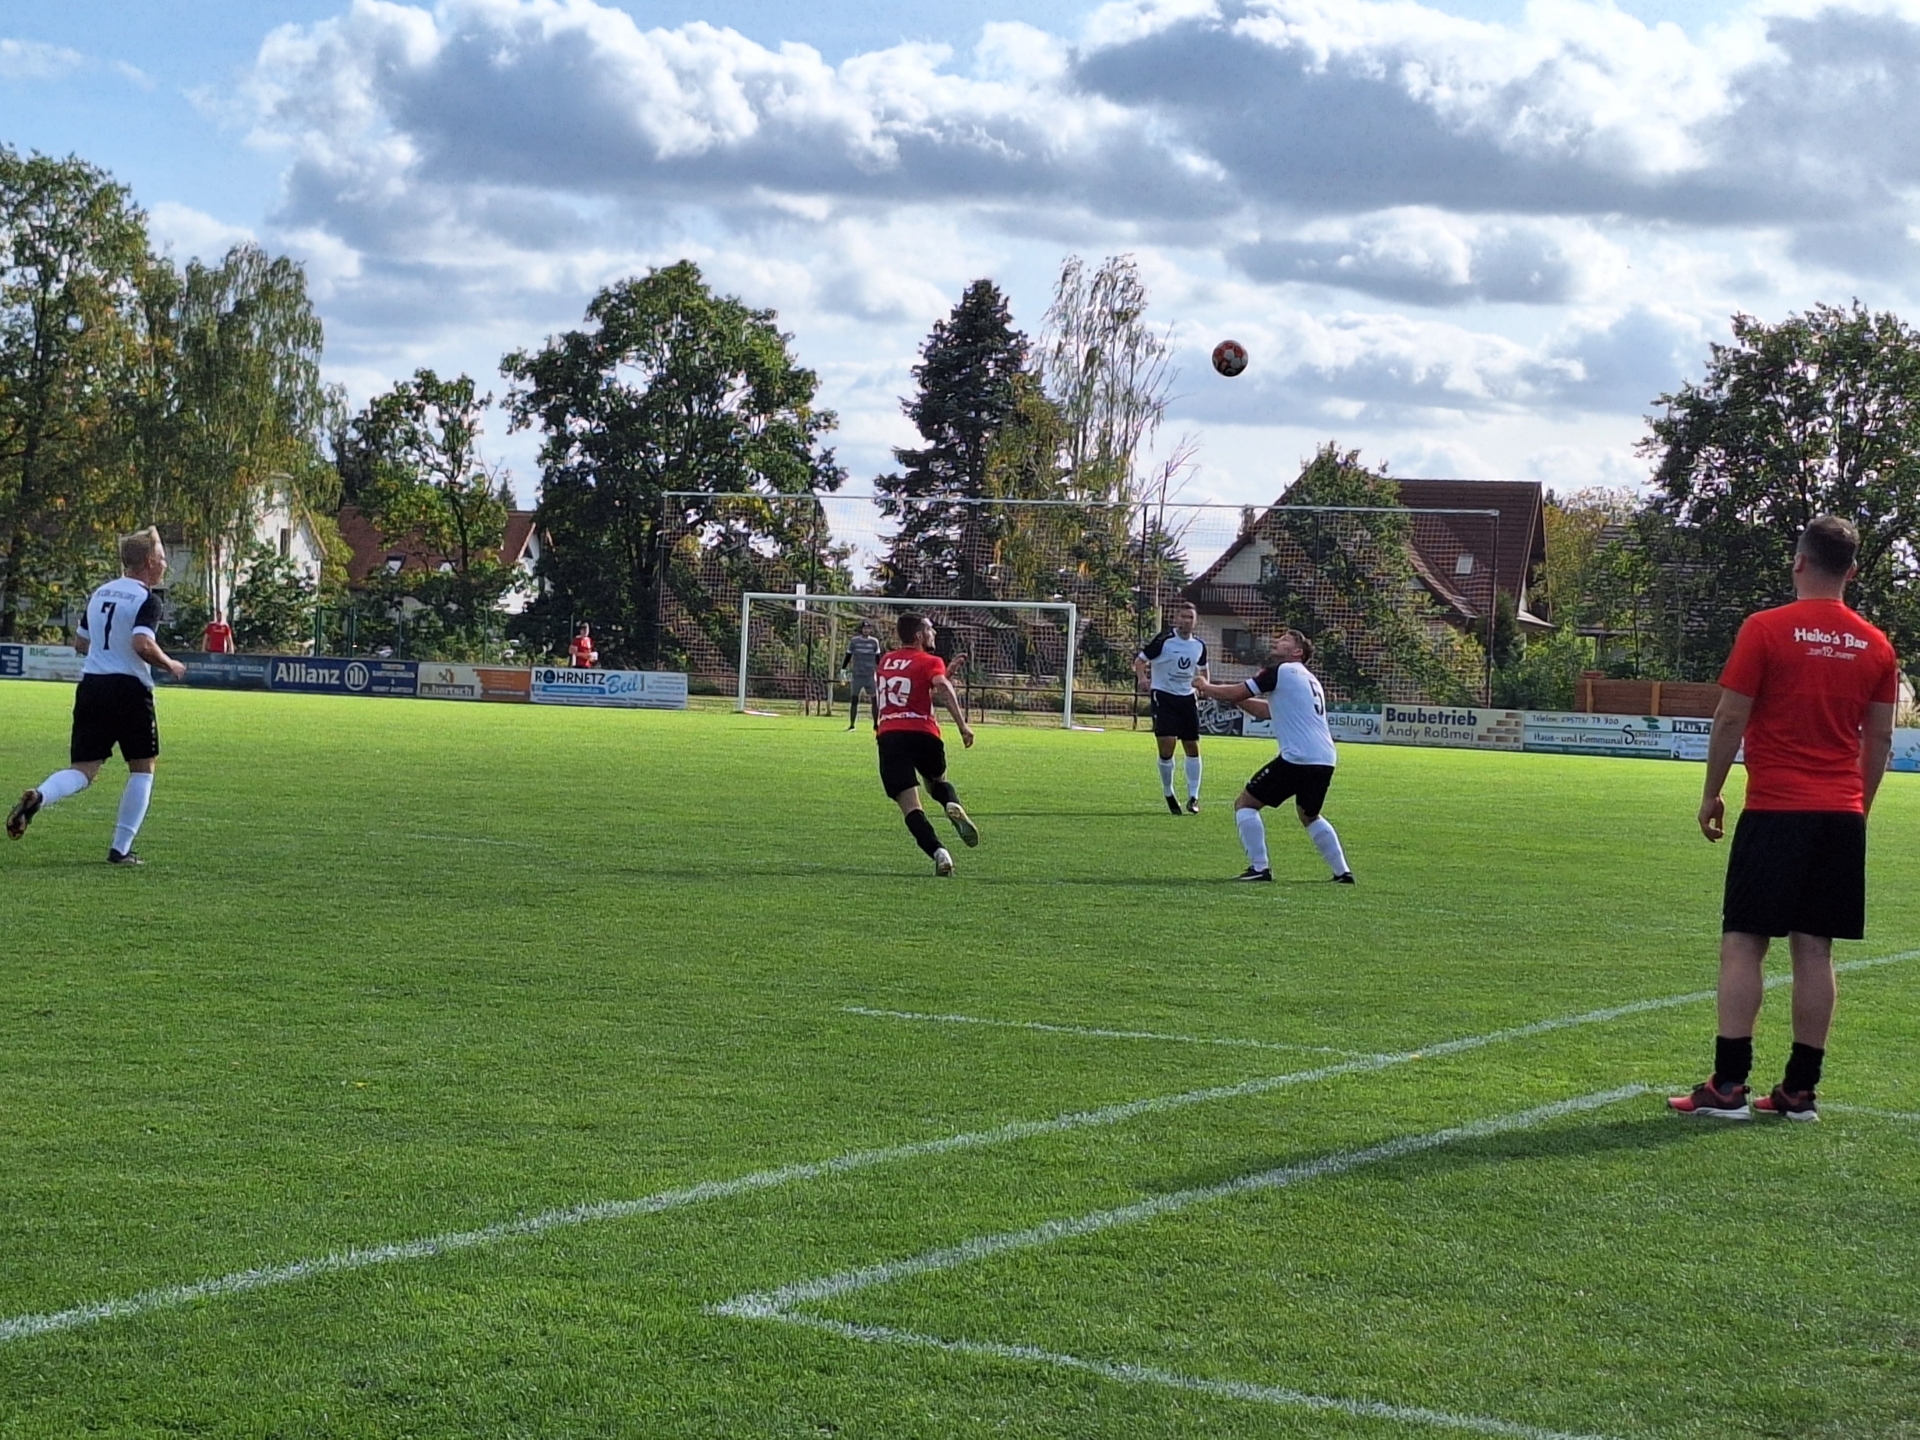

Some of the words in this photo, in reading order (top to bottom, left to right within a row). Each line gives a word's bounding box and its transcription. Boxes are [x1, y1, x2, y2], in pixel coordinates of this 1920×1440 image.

[101, 602, 117, 650] 7
[1794, 627, 1841, 645] Heiko's
[1842, 633, 1869, 650] Bar
[275, 662, 340, 684] Allianz
[883, 658, 912, 670] LSV
[535, 670, 606, 685] ROHRNETZ
[606, 673, 637, 694] Beil
[1309, 679, 1324, 716] 5
[1328, 715, 1374, 731] eistung
[1386, 707, 1477, 726] Baubetrieb
[1386, 726, 1420, 739] Andy
